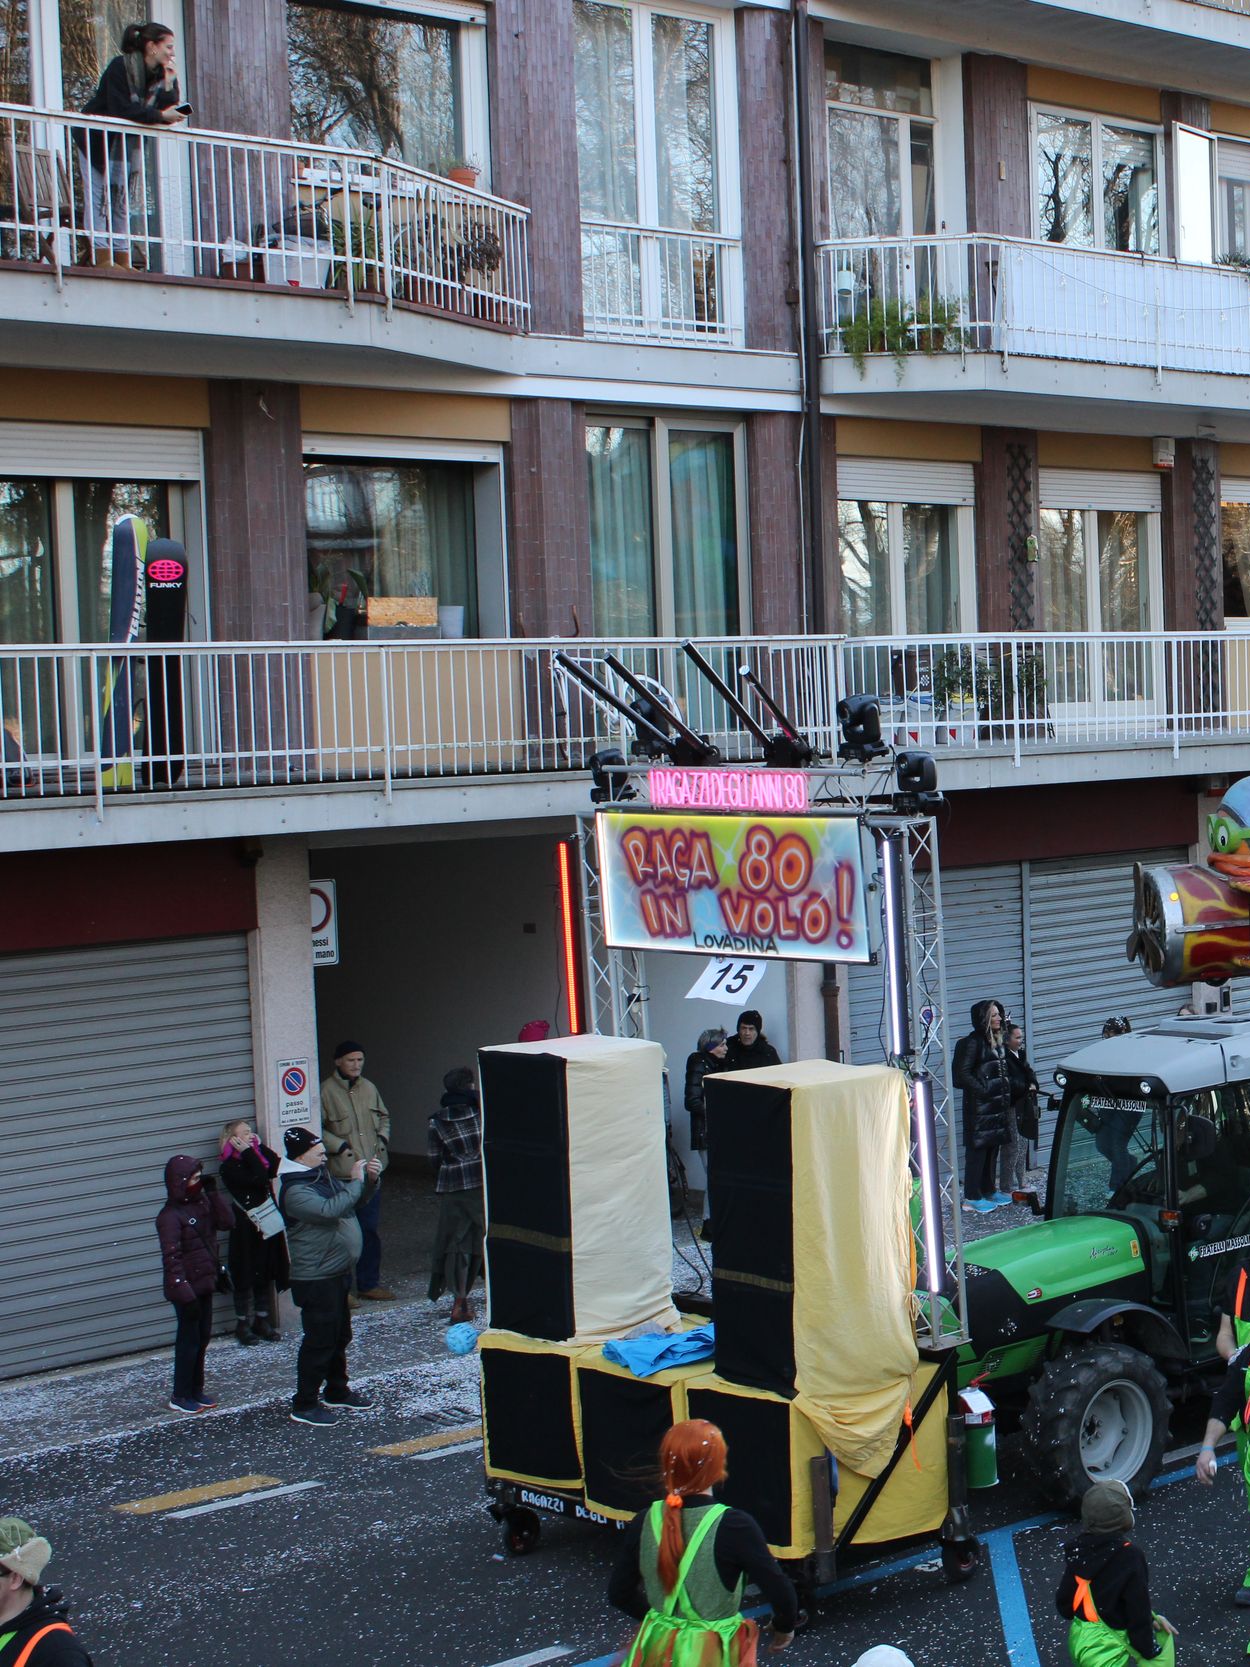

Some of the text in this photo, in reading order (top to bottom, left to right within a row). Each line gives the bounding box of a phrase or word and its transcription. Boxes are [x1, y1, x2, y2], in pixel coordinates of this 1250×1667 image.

[656, 771, 710, 806] RAGAZZI
[711, 772, 749, 807] DEGLI
[751, 773, 783, 808] ANNI
[784, 774, 806, 808] 80
[621, 825, 813, 895] RAGA 80
[640, 888, 691, 937] IN
[315, 950, 335, 959] mano
[693, 931, 779, 955] LOVADINA
[710, 963, 755, 994] 15
[281, 1107, 309, 1116] carrabile
[286, 1100, 303, 1108] passo
[1200, 1241, 1226, 1258] FRATELLI
[521, 1490, 564, 1513] RAGAZZI
